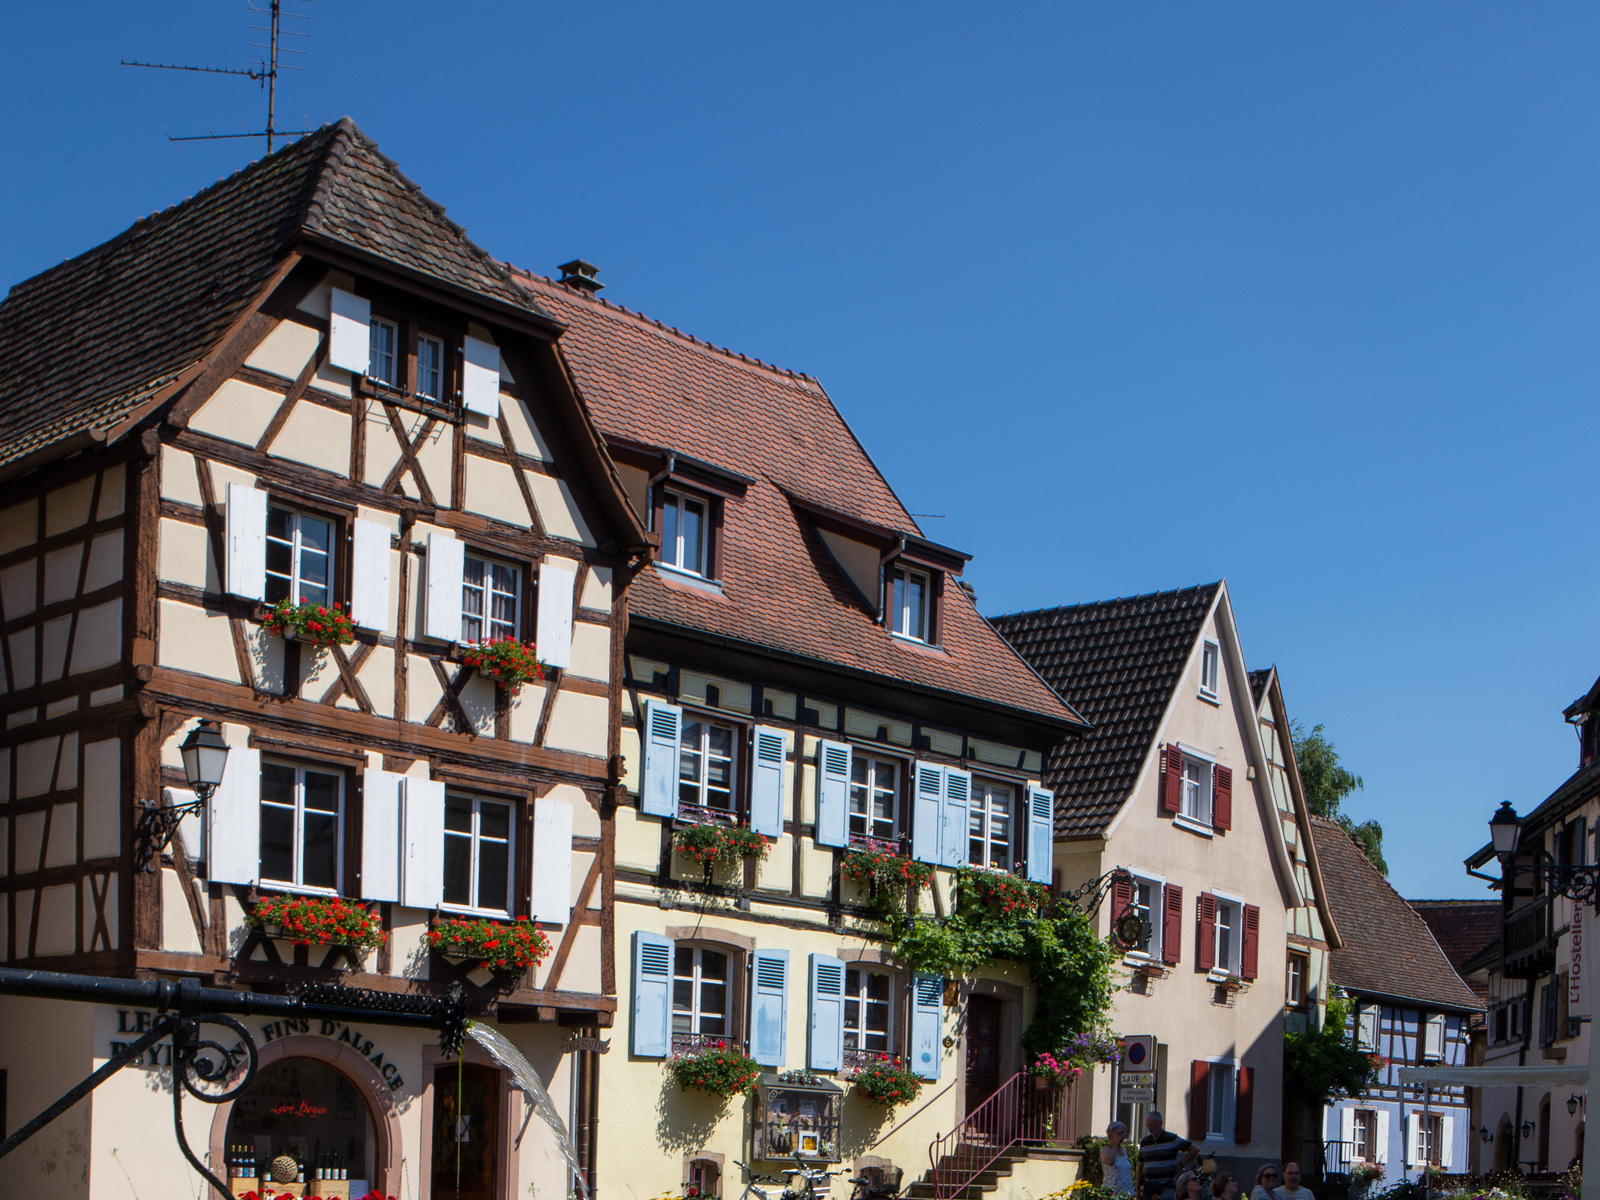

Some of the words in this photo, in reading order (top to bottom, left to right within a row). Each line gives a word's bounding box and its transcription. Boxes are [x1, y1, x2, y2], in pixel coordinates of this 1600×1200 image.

[262, 1018, 310, 1043] FINS
[319, 1020, 405, 1092] D'ALSACE
[1122, 1075, 1139, 1083] SAUF
